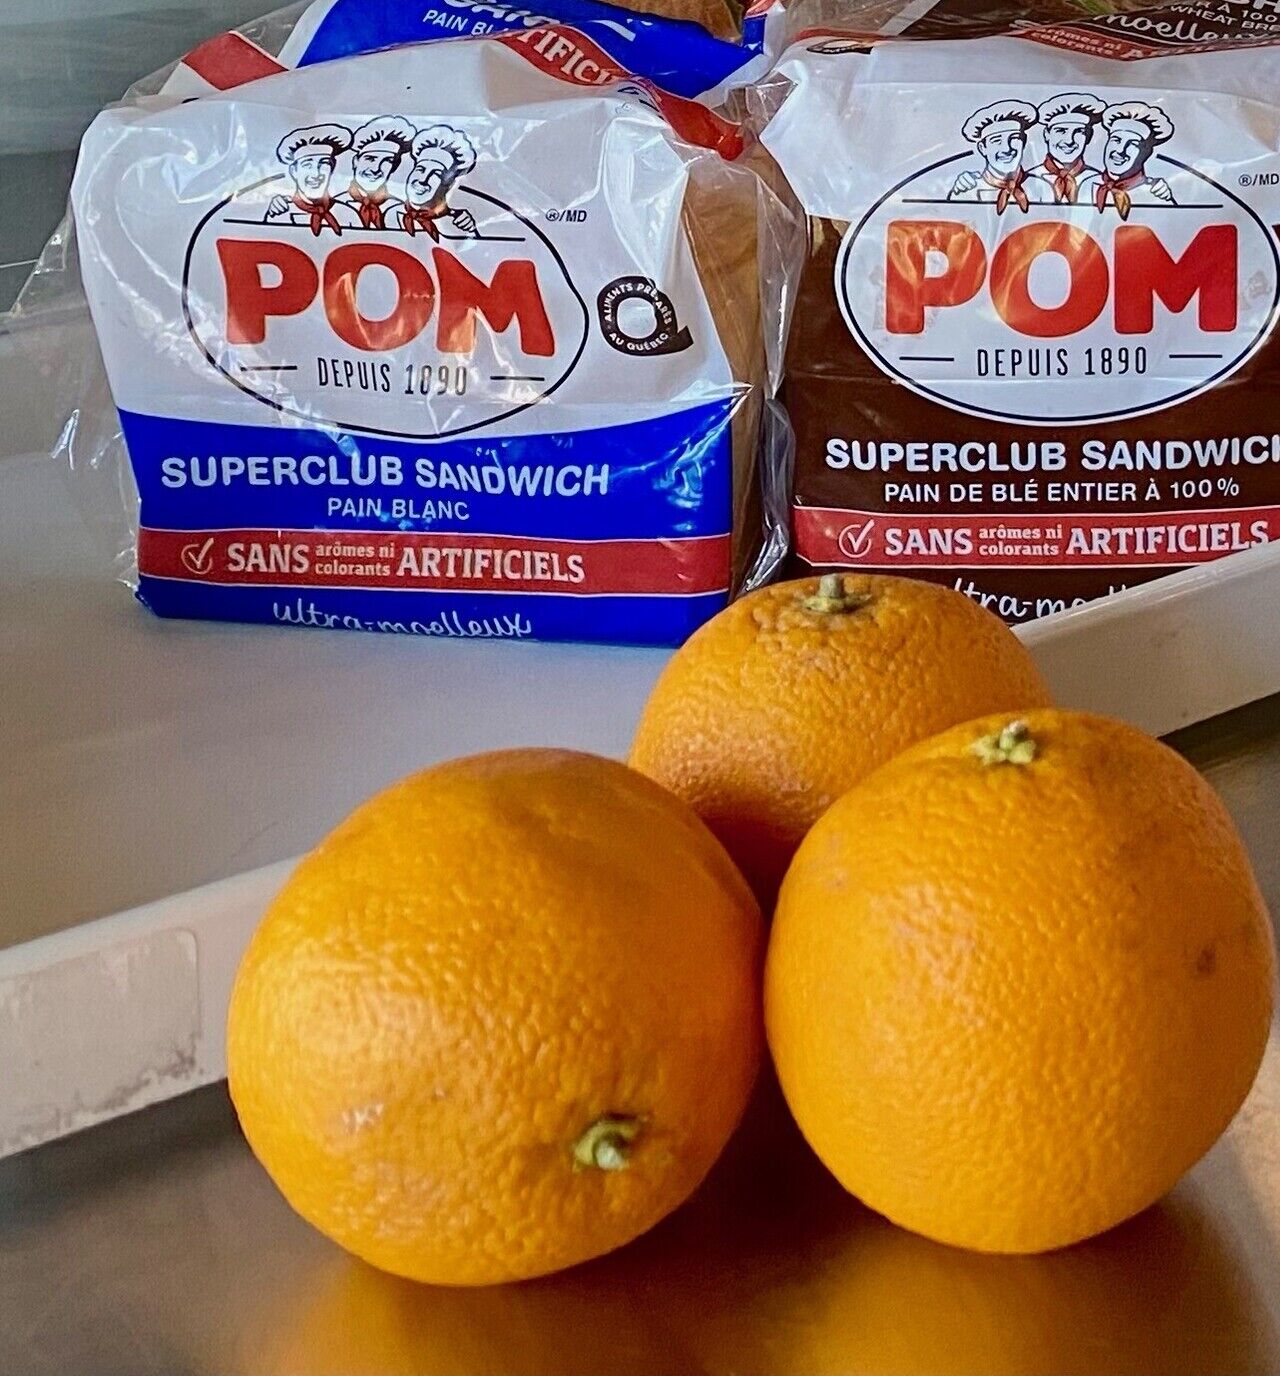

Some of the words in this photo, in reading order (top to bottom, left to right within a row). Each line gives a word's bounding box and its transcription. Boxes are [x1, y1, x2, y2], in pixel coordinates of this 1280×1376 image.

[422, 9, 468, 32] PAIN
[1170, 5, 1238, 26] WHEAT
[885, 221, 1237, 338] POM
[215, 237, 556, 358] POM
[603, 282, 634, 323] ALIMENTS
[609, 332, 625, 346] AU
[317, 356, 392, 394] DEPUIS
[977, 348, 1069, 377] DEPUIS
[1084, 346, 1148, 376] 1890
[825, 438, 1066, 472] SUPERCLUB
[161, 455, 402, 488] SUPERCLUB
[415, 458, 610, 497] SANDWICH
[884, 483, 939, 503] PAIN
[950, 483, 983, 502] DE
[992, 478, 1038, 502] BLÉ
[1048, 482, 1136, 501] ENTIER
[1144, 477, 1161, 501] À
[327, 498, 381, 517] PAIN
[391, 499, 471, 521] BLANC
[884, 526, 973, 556] SANS
[978, 524, 1042, 539] arômes
[1045, 523, 1063, 539] ni
[1065, 520, 1270, 555] ARTIFICIELS
[978, 541, 1060, 556] colorants
[227, 542, 309, 574] SANS
[315, 541, 376, 558] arômes
[379, 542, 395, 558] ni
[396, 546, 586, 584] ARTIFICIELS
[315, 560, 390, 577] colorants
